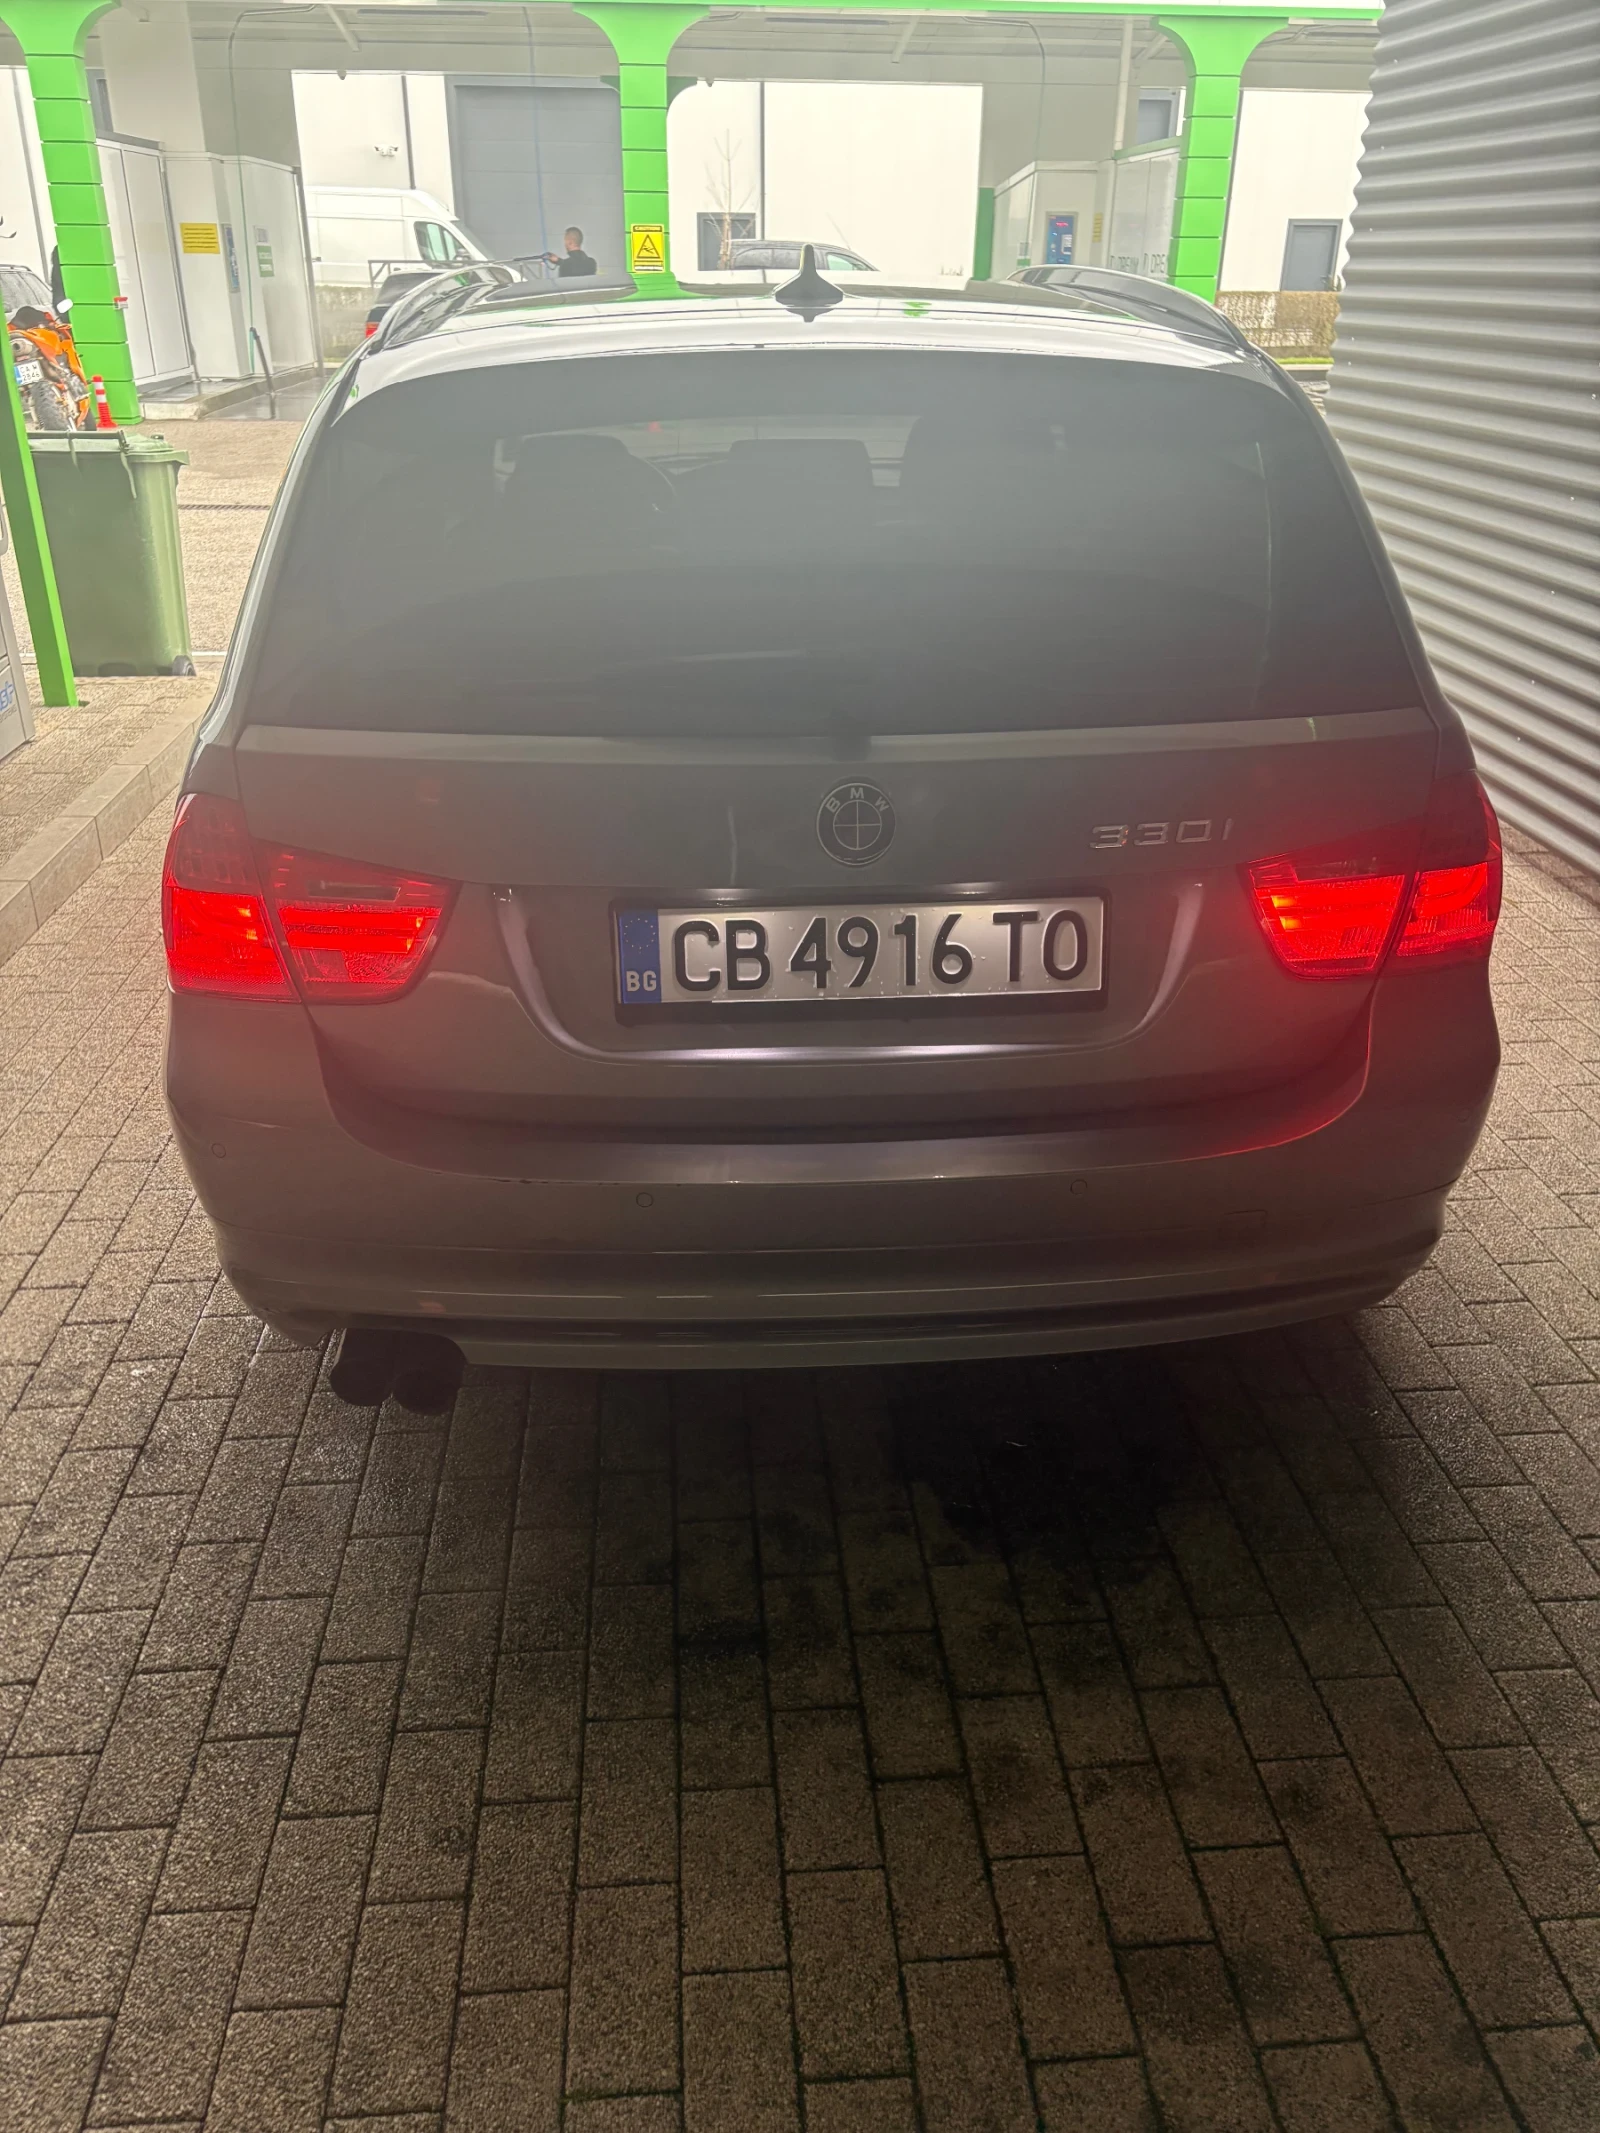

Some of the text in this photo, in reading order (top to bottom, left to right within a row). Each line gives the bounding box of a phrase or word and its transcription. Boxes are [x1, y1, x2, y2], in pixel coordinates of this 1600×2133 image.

[825, 787, 890, 813] BMW
[673, 916, 771, 992] CB
[790, 912, 974, 989] 4916
[625, 969, 658, 993] BG
